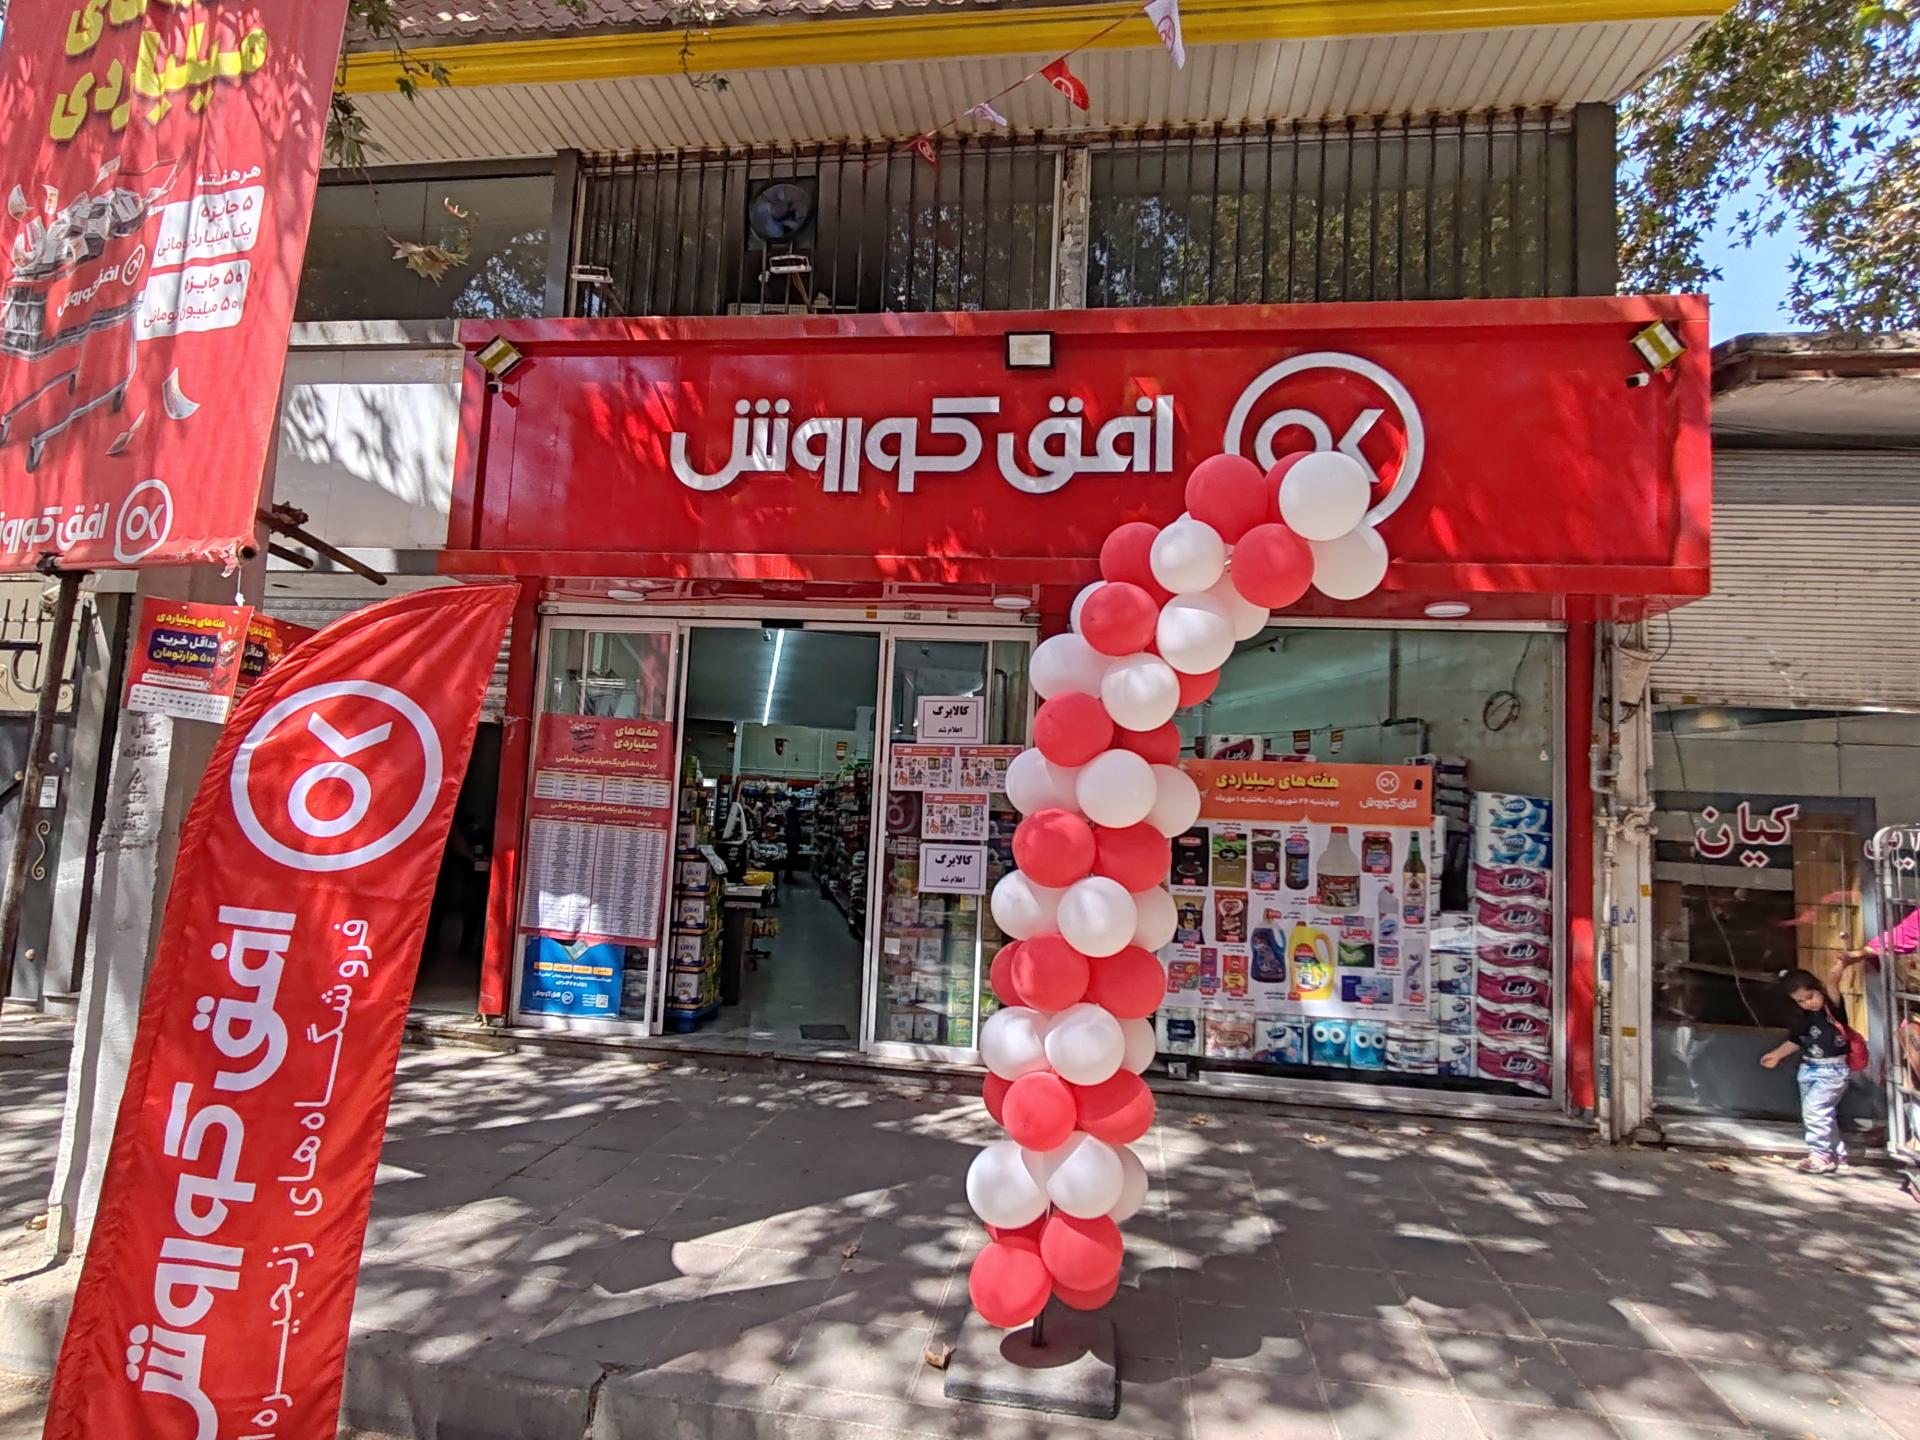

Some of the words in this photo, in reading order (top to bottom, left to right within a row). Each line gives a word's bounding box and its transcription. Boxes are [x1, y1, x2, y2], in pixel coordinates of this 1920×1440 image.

[201, 202, 239, 222] جایزه
[243, 196, 253, 209] ۵
[233, 222, 252, 239] یک
[184, 274, 220, 294] جایزه
[223, 271, 243, 283] ۵۰
[220, 298, 239, 311] ۵۰
[670, 396, 1001, 494] کوروش
[997, 394, 1174, 494] افق
[0, 506, 64, 554] کورو
[56, 502, 111, 551] افق
[156, 634, 189, 647] خرید
[932, 705, 969, 718] کالابرگ
[947, 726, 963, 734] اعلام
[1216, 771, 1275, 790] میلیاردی
[1695, 801, 1798, 867] کیان
[935, 855, 973, 868] کالابرگ
[949, 876, 965, 884] اعلام
[192, 905, 297, 1092] افق
[125, 1082, 256, 1440] کوروش
